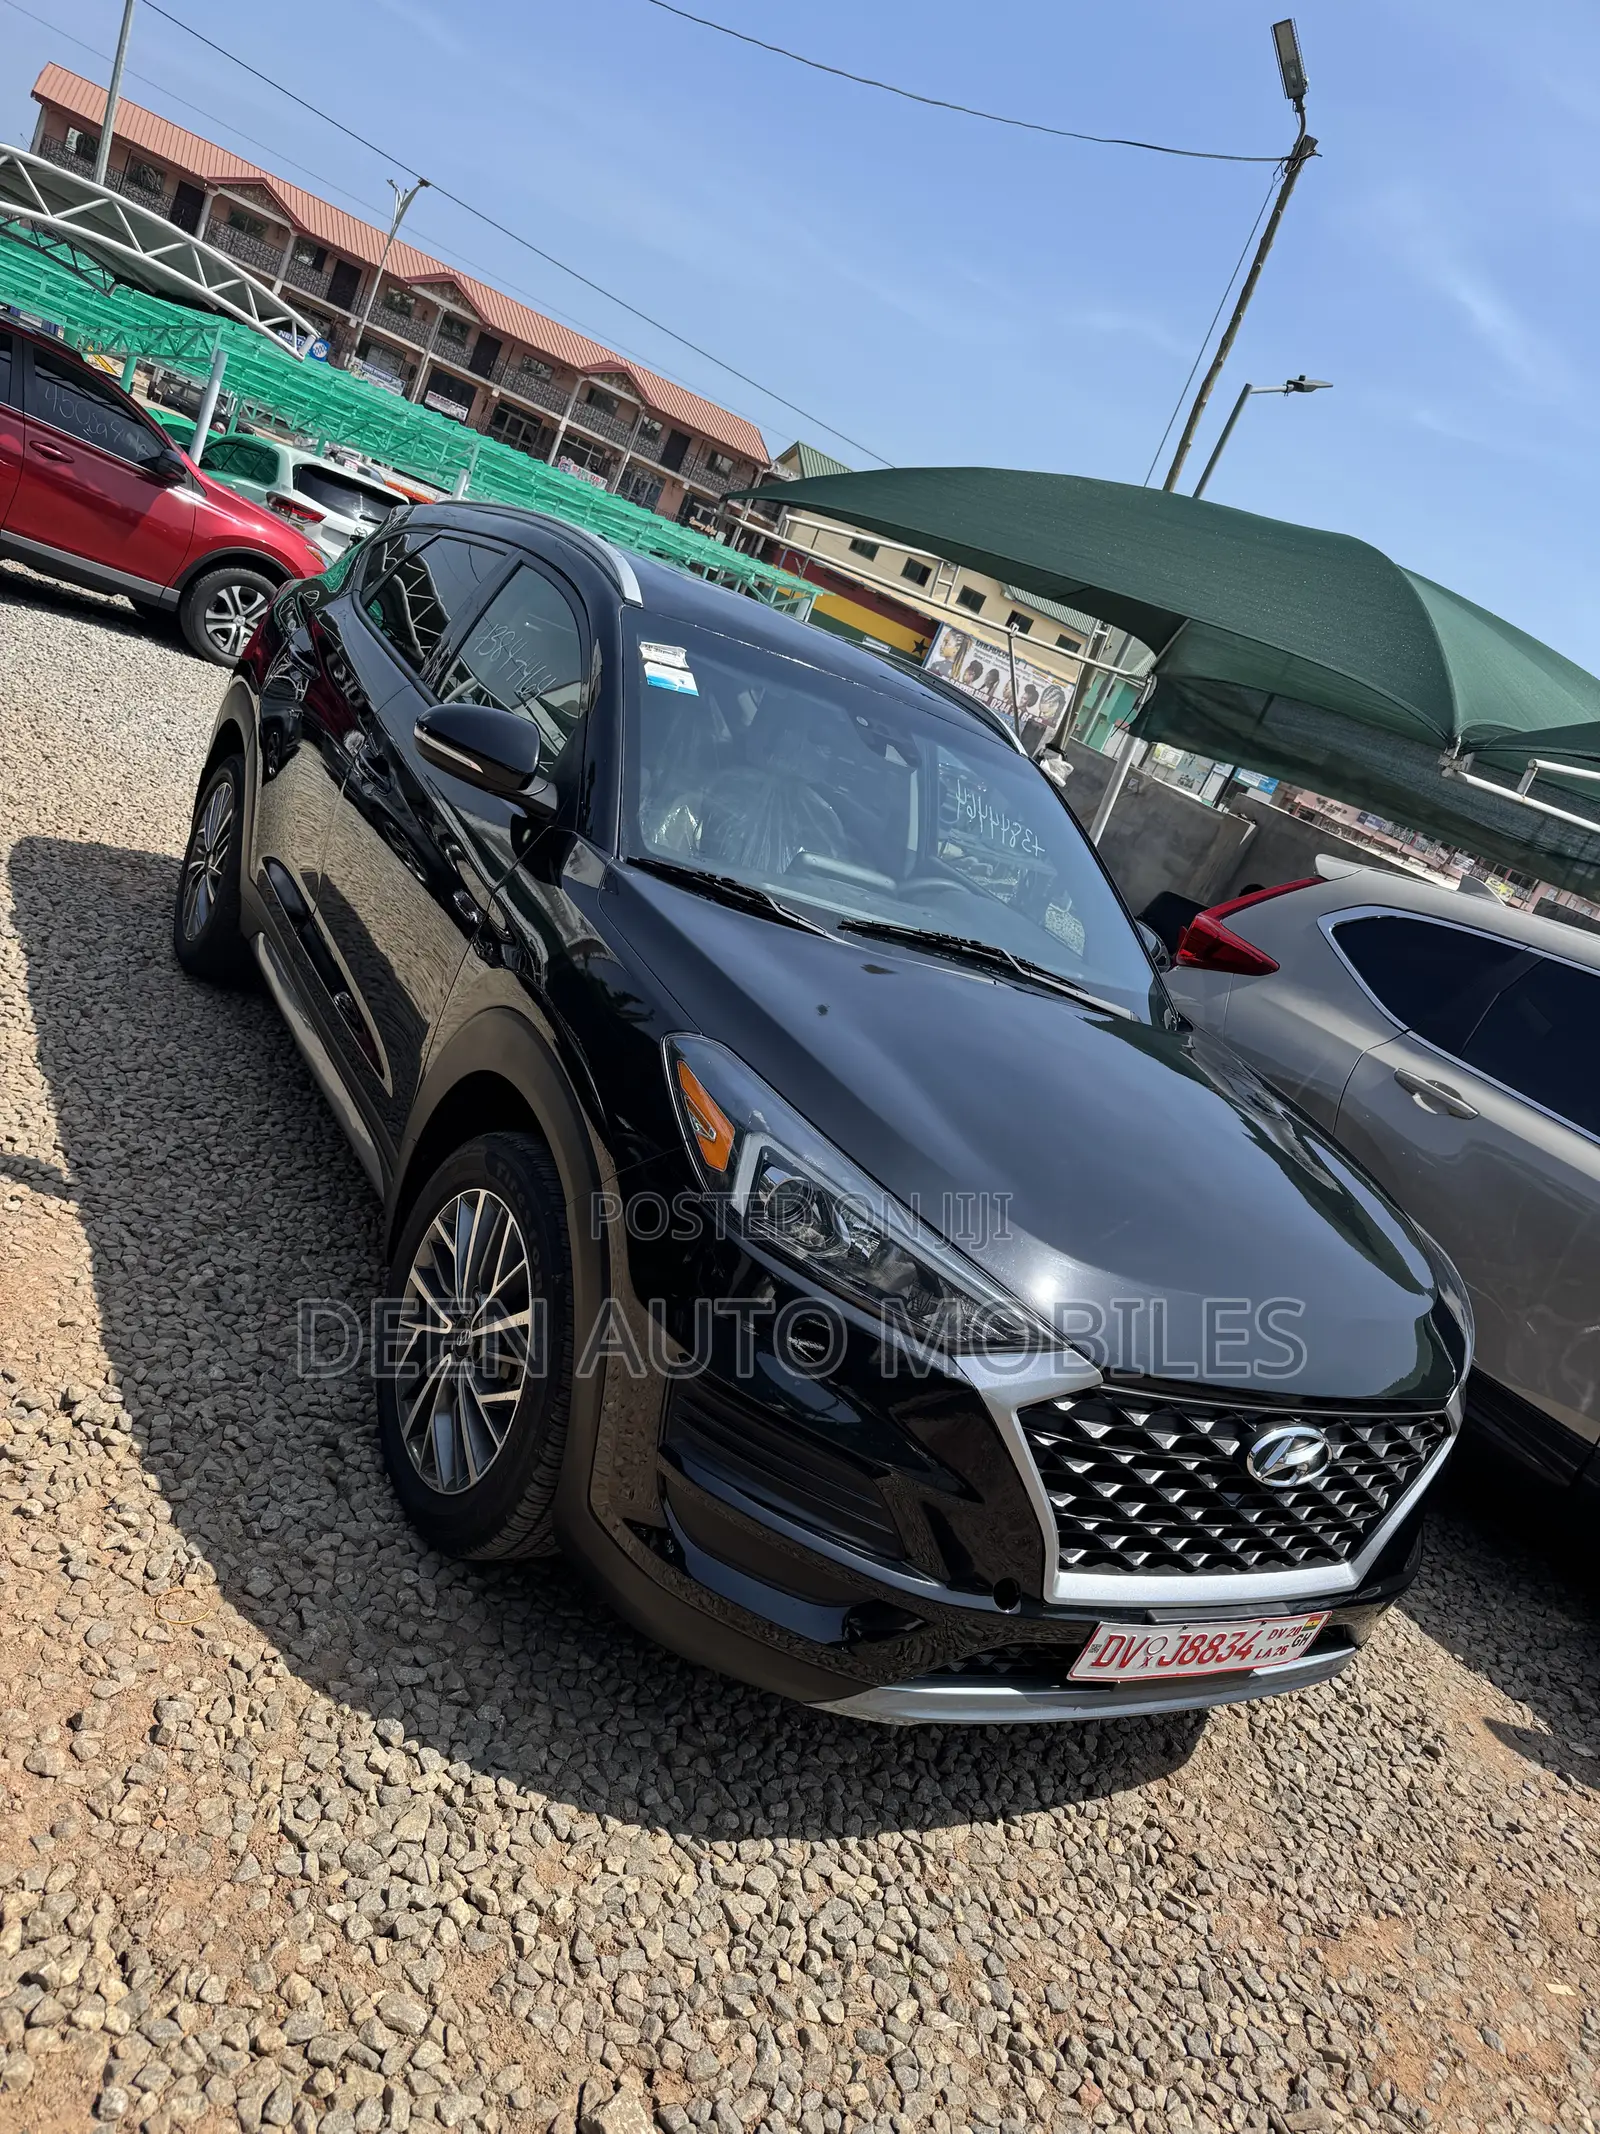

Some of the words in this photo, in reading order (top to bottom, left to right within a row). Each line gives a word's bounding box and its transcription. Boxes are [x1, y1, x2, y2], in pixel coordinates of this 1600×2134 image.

[1266, 1628, 1288, 1640] DV
[1291, 1632, 1313, 1648] GH
[1089, 1633, 1152, 1669] DV
[1157, 1630, 1264, 1667] J8834
[1254, 1646, 1273, 1660] LA
